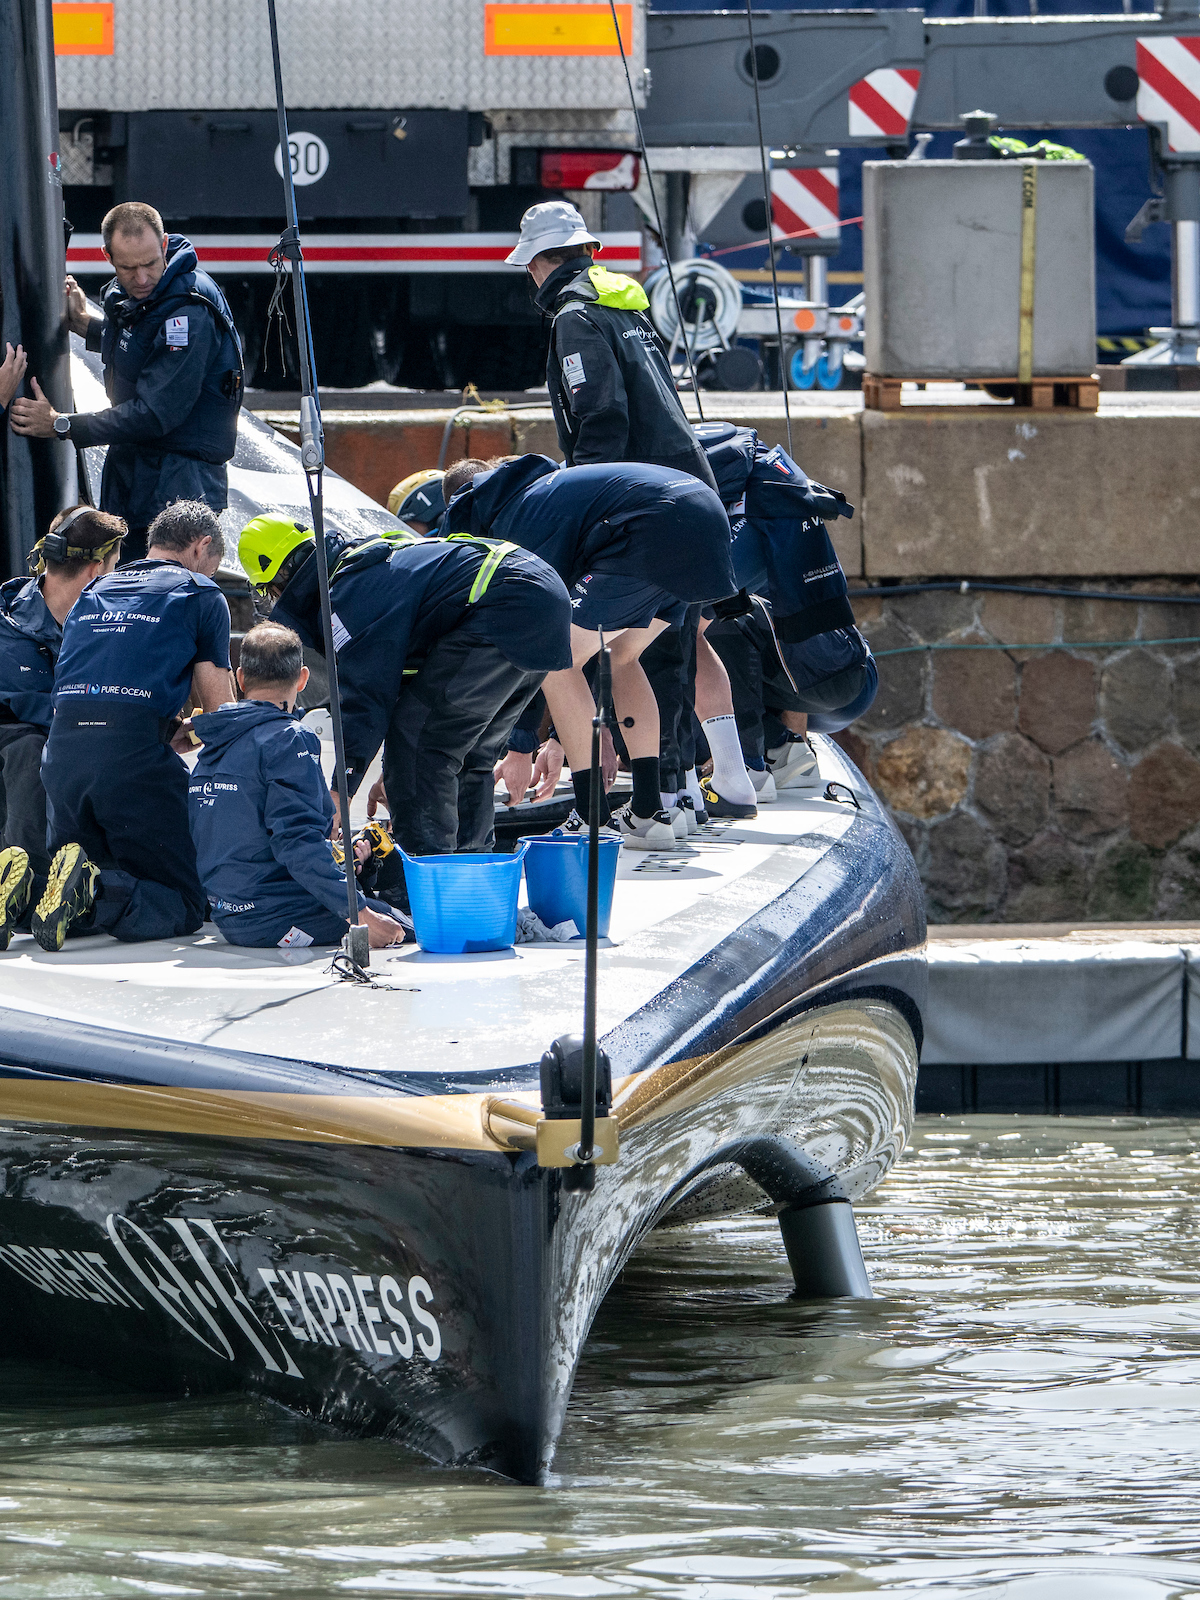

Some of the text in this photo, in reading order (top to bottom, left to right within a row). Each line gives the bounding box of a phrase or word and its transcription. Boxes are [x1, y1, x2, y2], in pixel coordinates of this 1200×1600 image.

[416, 491, 432, 507] 1
[79, 613, 101, 622] ORIENT
[127, 613, 161, 623] EXPRESS
[101, 686, 120, 694] PURE
[121, 687, 152, 698] OCEAN
[257, 1267, 442, 1363] EXPRESS
